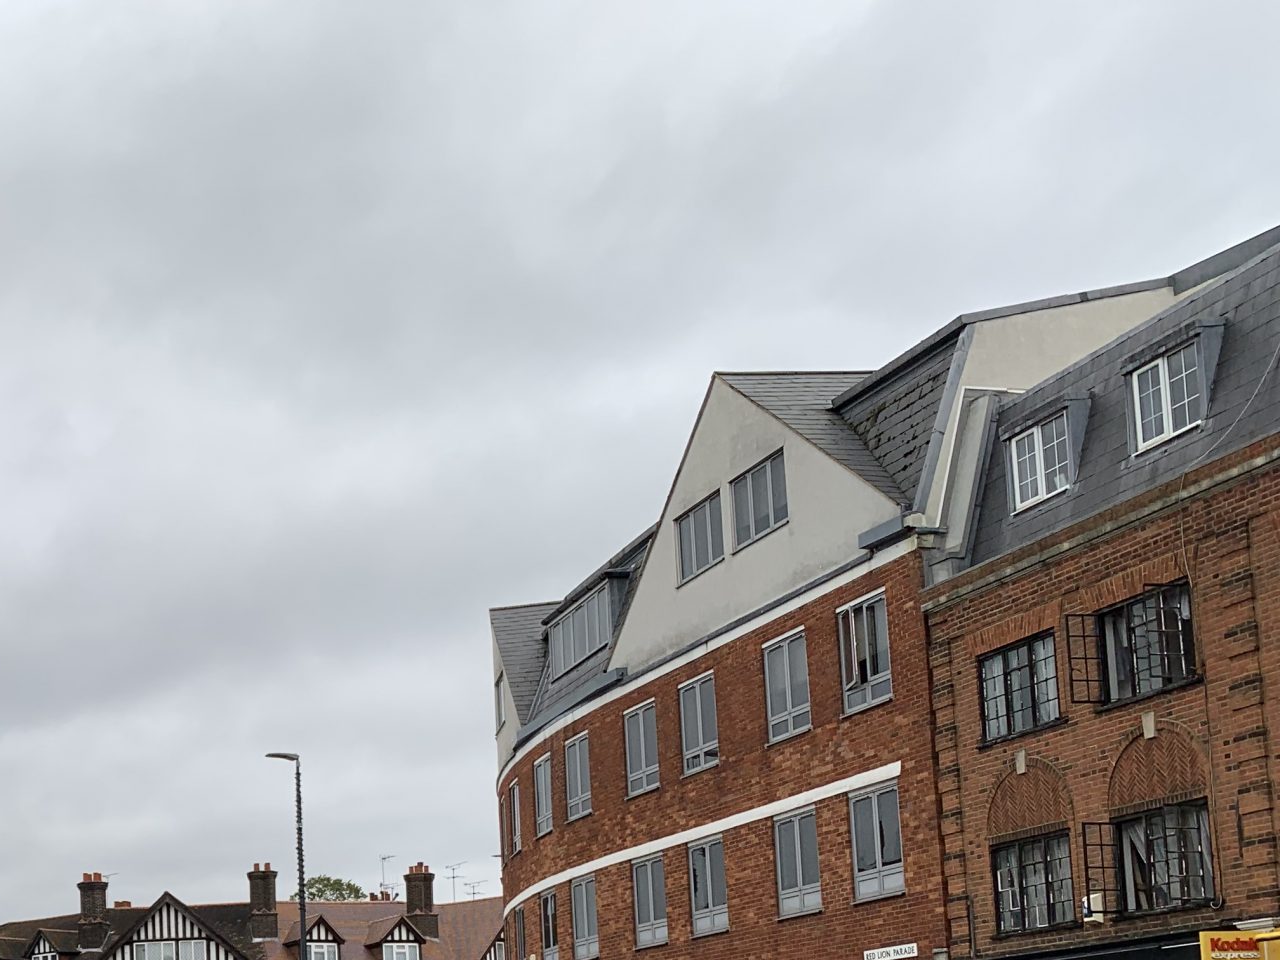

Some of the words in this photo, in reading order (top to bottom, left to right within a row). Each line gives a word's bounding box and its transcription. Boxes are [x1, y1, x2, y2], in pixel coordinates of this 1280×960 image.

[1210, 938, 1259, 952] Kodak
[866, 953, 876, 960] RED
[878, 950, 891, 959] LION
[893, 946, 915, 957] PARADE
[1211, 952, 1260, 960] express
